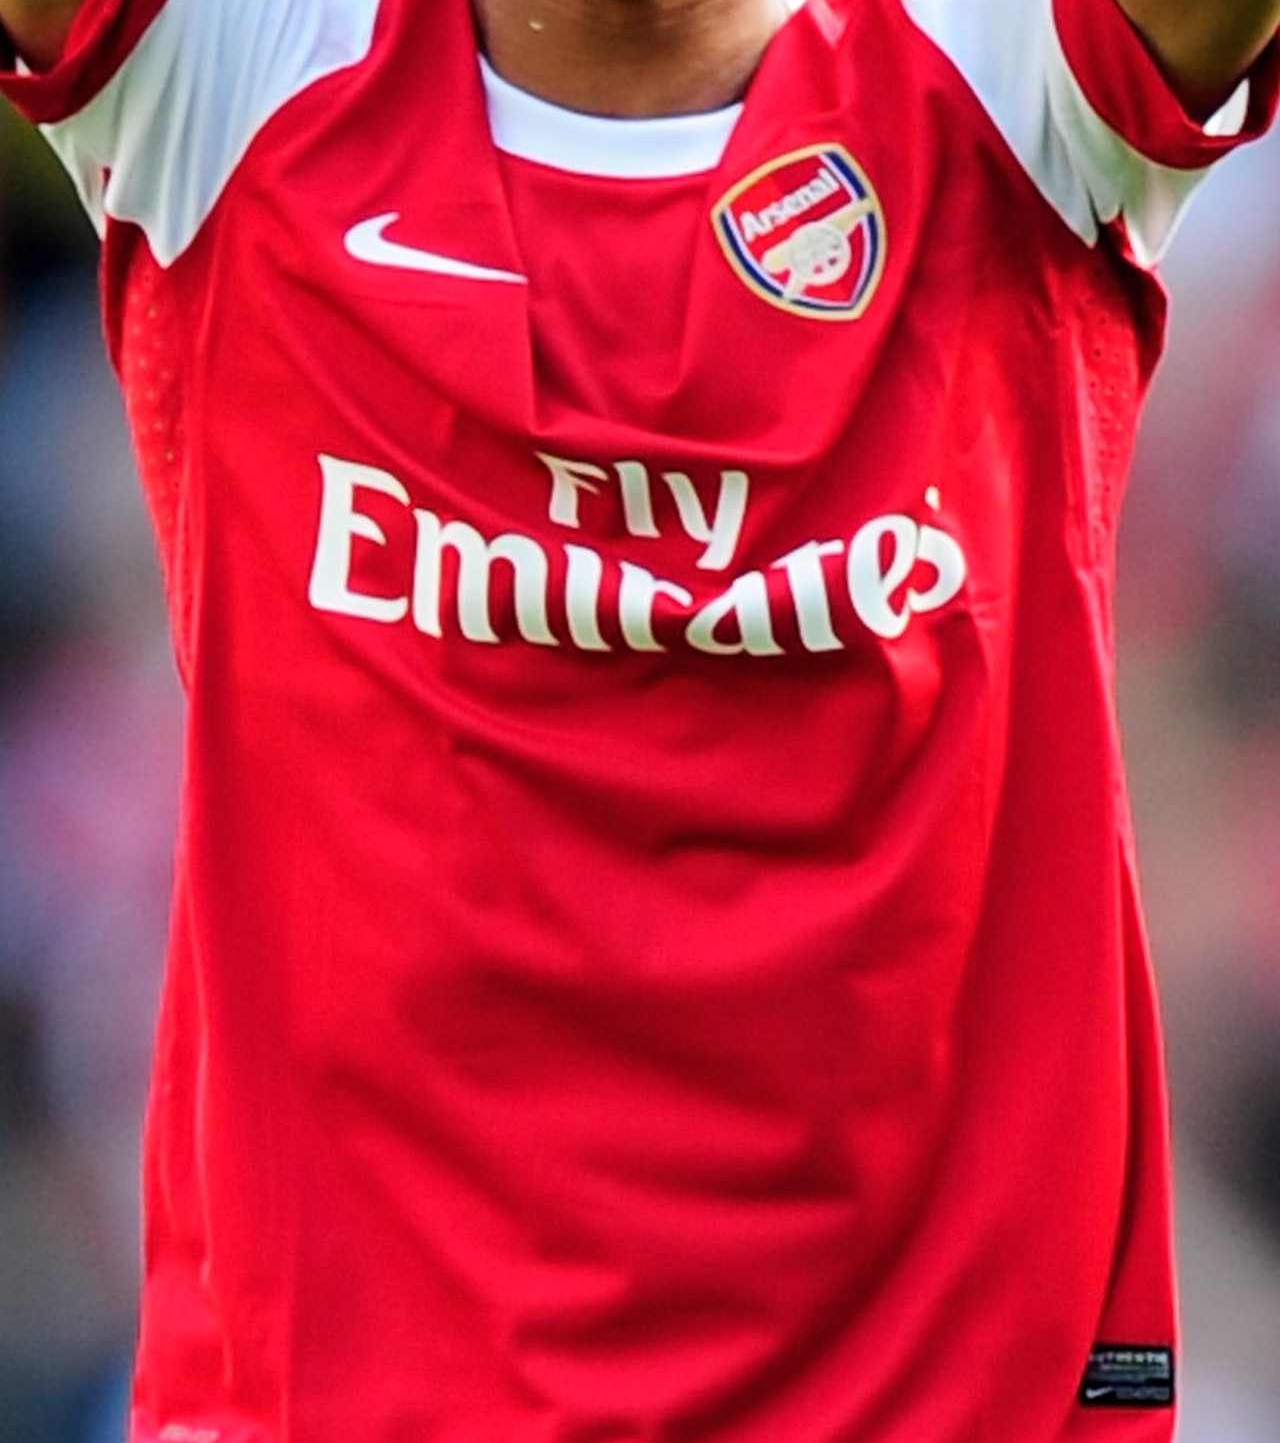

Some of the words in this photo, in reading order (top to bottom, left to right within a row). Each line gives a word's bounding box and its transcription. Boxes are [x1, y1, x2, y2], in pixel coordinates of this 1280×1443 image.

[740, 167, 840, 242] Arsenal
[308, 453, 967, 656] Emirates
[536, 451, 748, 569] Fly
